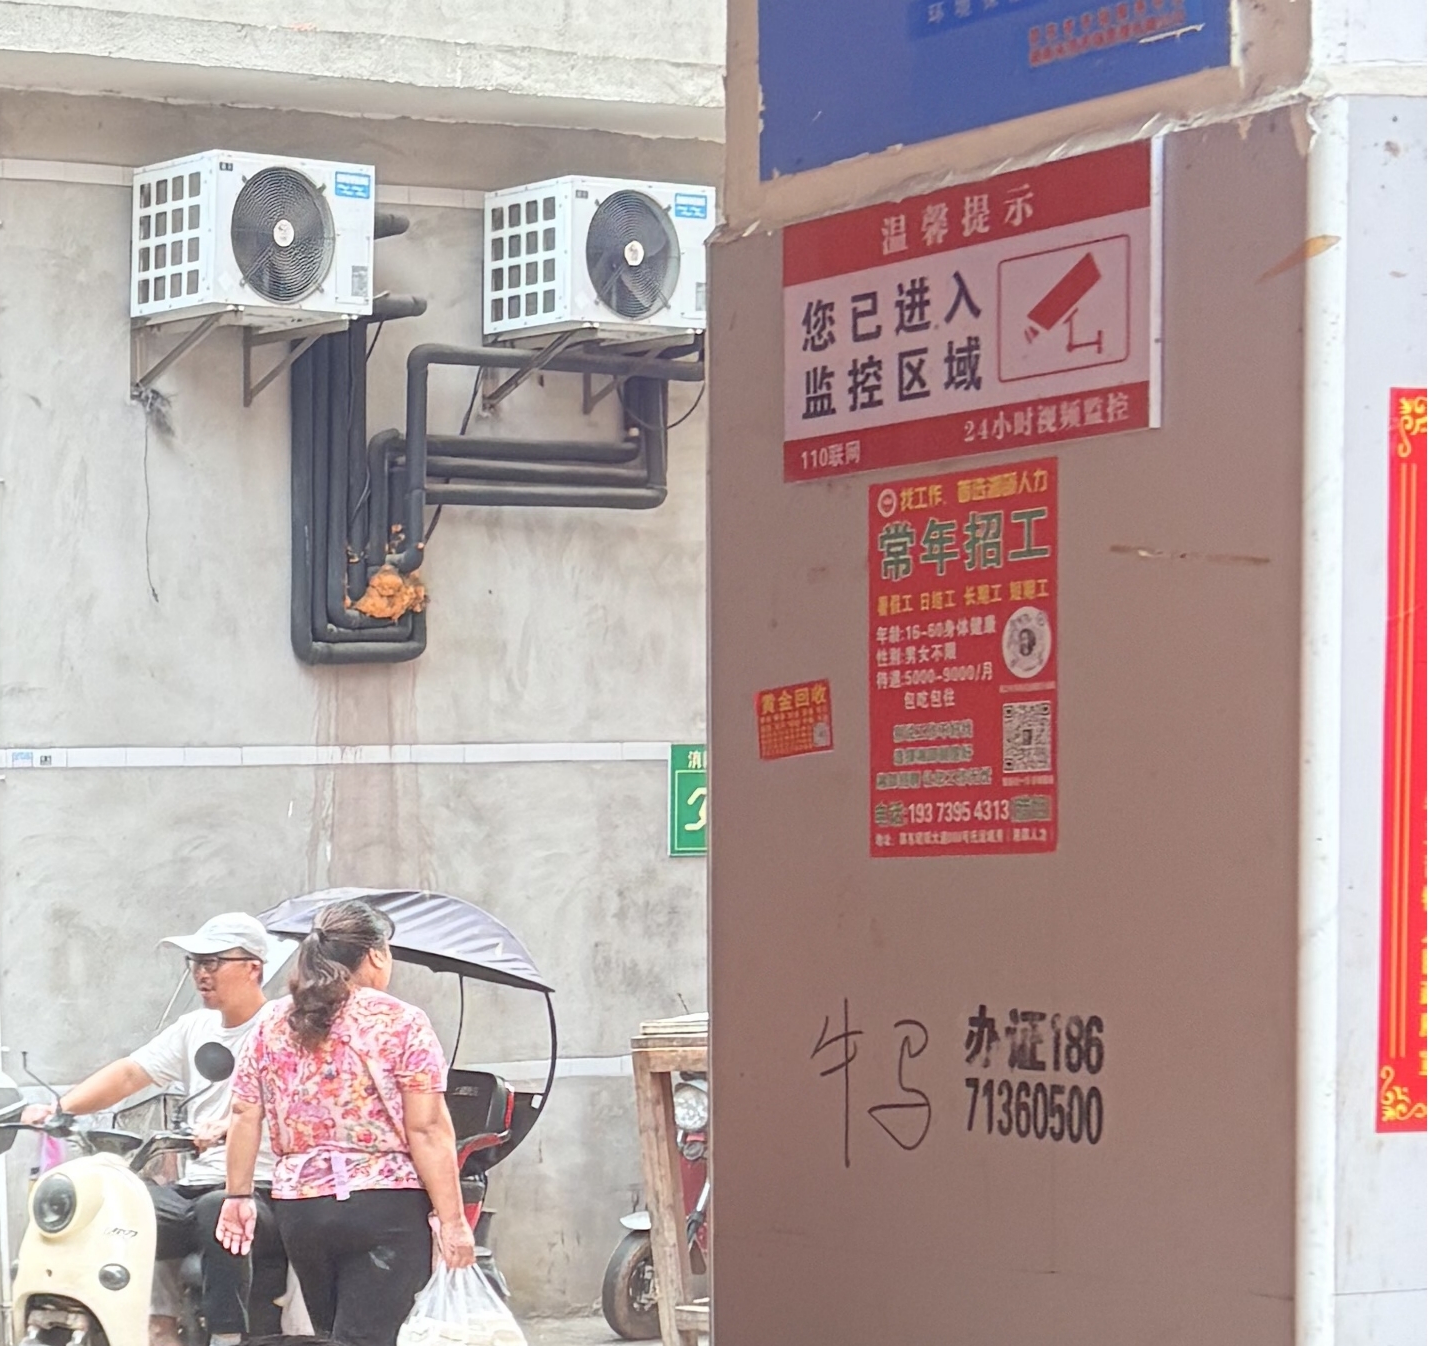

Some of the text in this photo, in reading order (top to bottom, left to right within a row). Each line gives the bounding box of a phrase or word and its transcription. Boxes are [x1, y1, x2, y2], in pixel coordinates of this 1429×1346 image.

[881, 184, 1034, 256] 温馨提示
[801, 270, 982, 353] 您已进入
[801, 336, 983, 420] 监控区域
[963, 392, 1130, 443] 24小时视频监控
[800, 440, 862, 470] 110联网
[878, 506, 1052, 582] 常年招工
[964, 1004, 1106, 1075] 办证186
[964, 1077, 1105, 1146] 71360500
